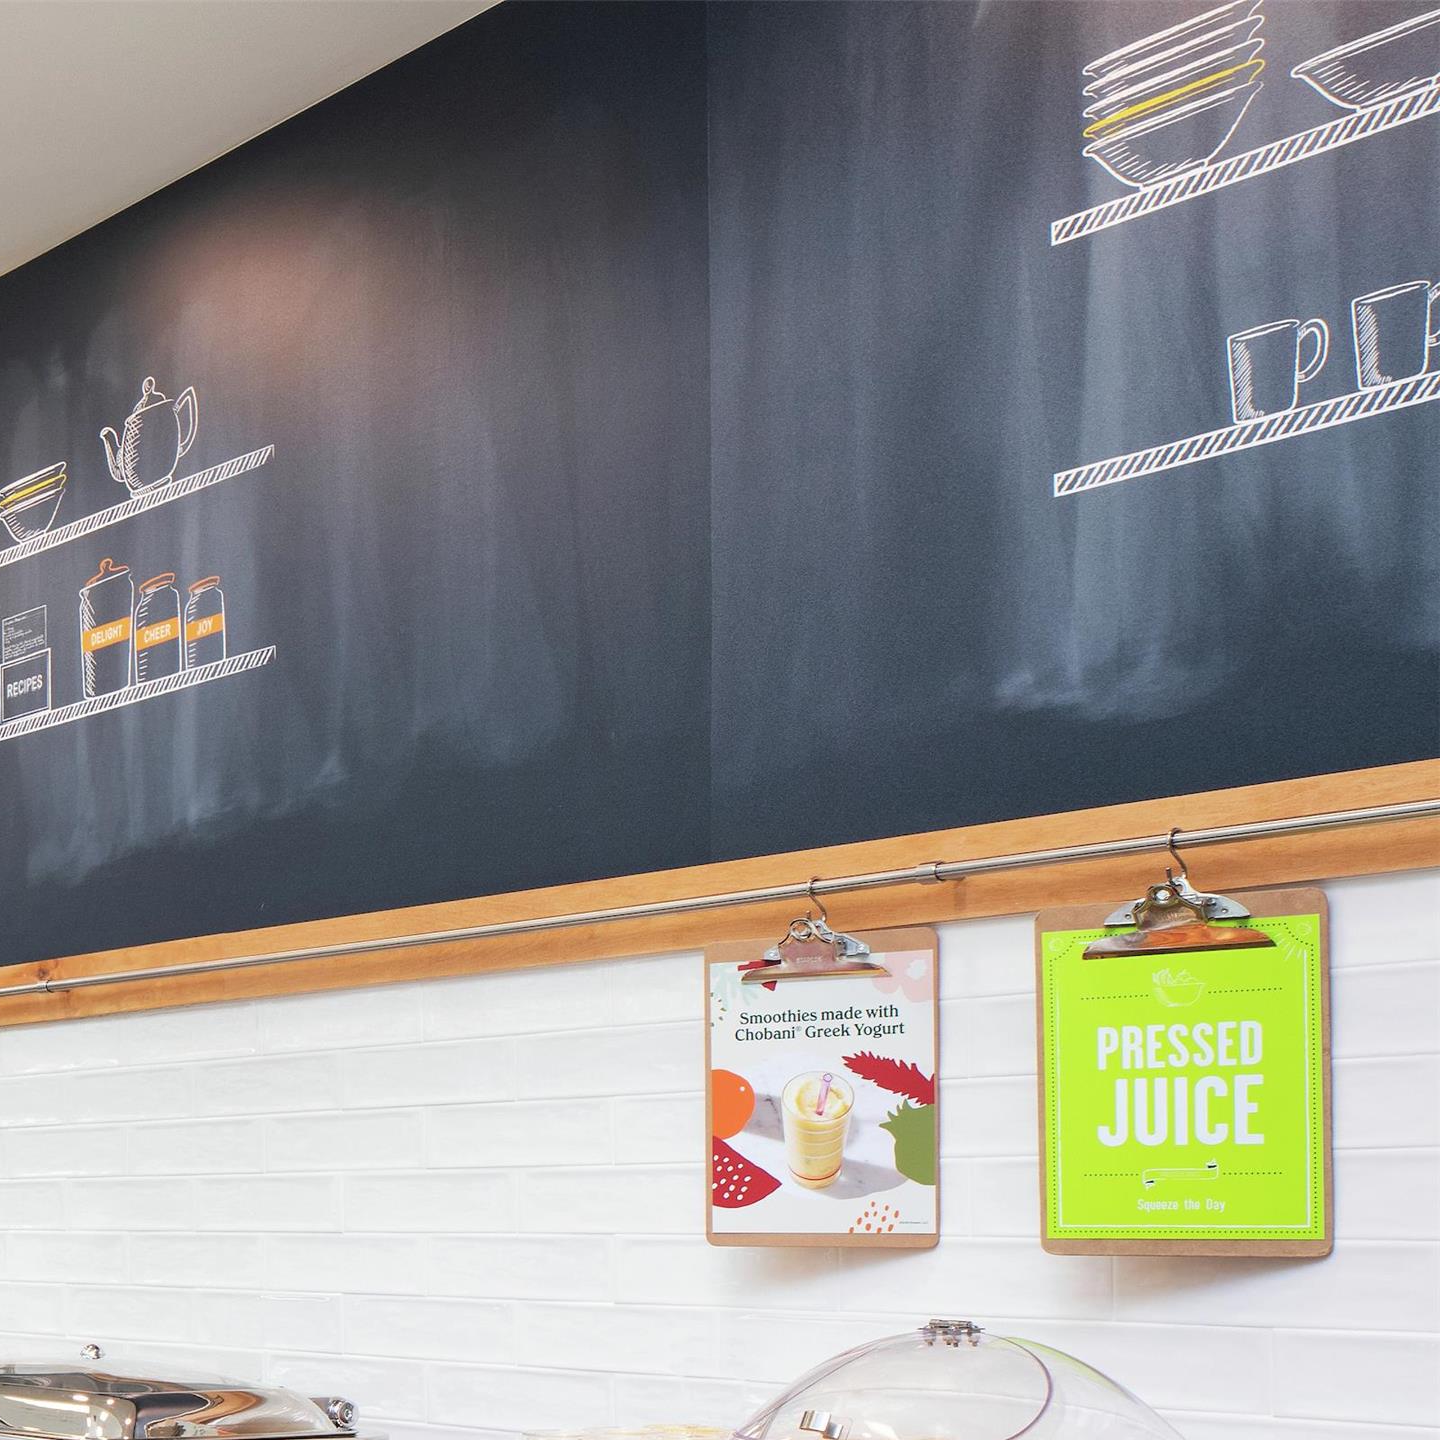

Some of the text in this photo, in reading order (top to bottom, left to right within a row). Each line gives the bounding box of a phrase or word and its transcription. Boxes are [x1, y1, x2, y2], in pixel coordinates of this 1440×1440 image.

[90, 624, 123, 646] DELIGHT
[143, 623, 172, 643] CHEER
[196, 618, 213, 635] JOY
[6, 674, 43, 698] RECIPES
[739, 1005, 899, 1025] Smoothies made with
[805, 1024, 850, 1039] Greek
[854, 1022, 905, 1038] Yogurt
[1097, 1020, 1263, 1070] PRESSED
[1097, 1074, 1265, 1147] JUICE
[1137, 1199, 1225, 1212] Squeeze the Day
